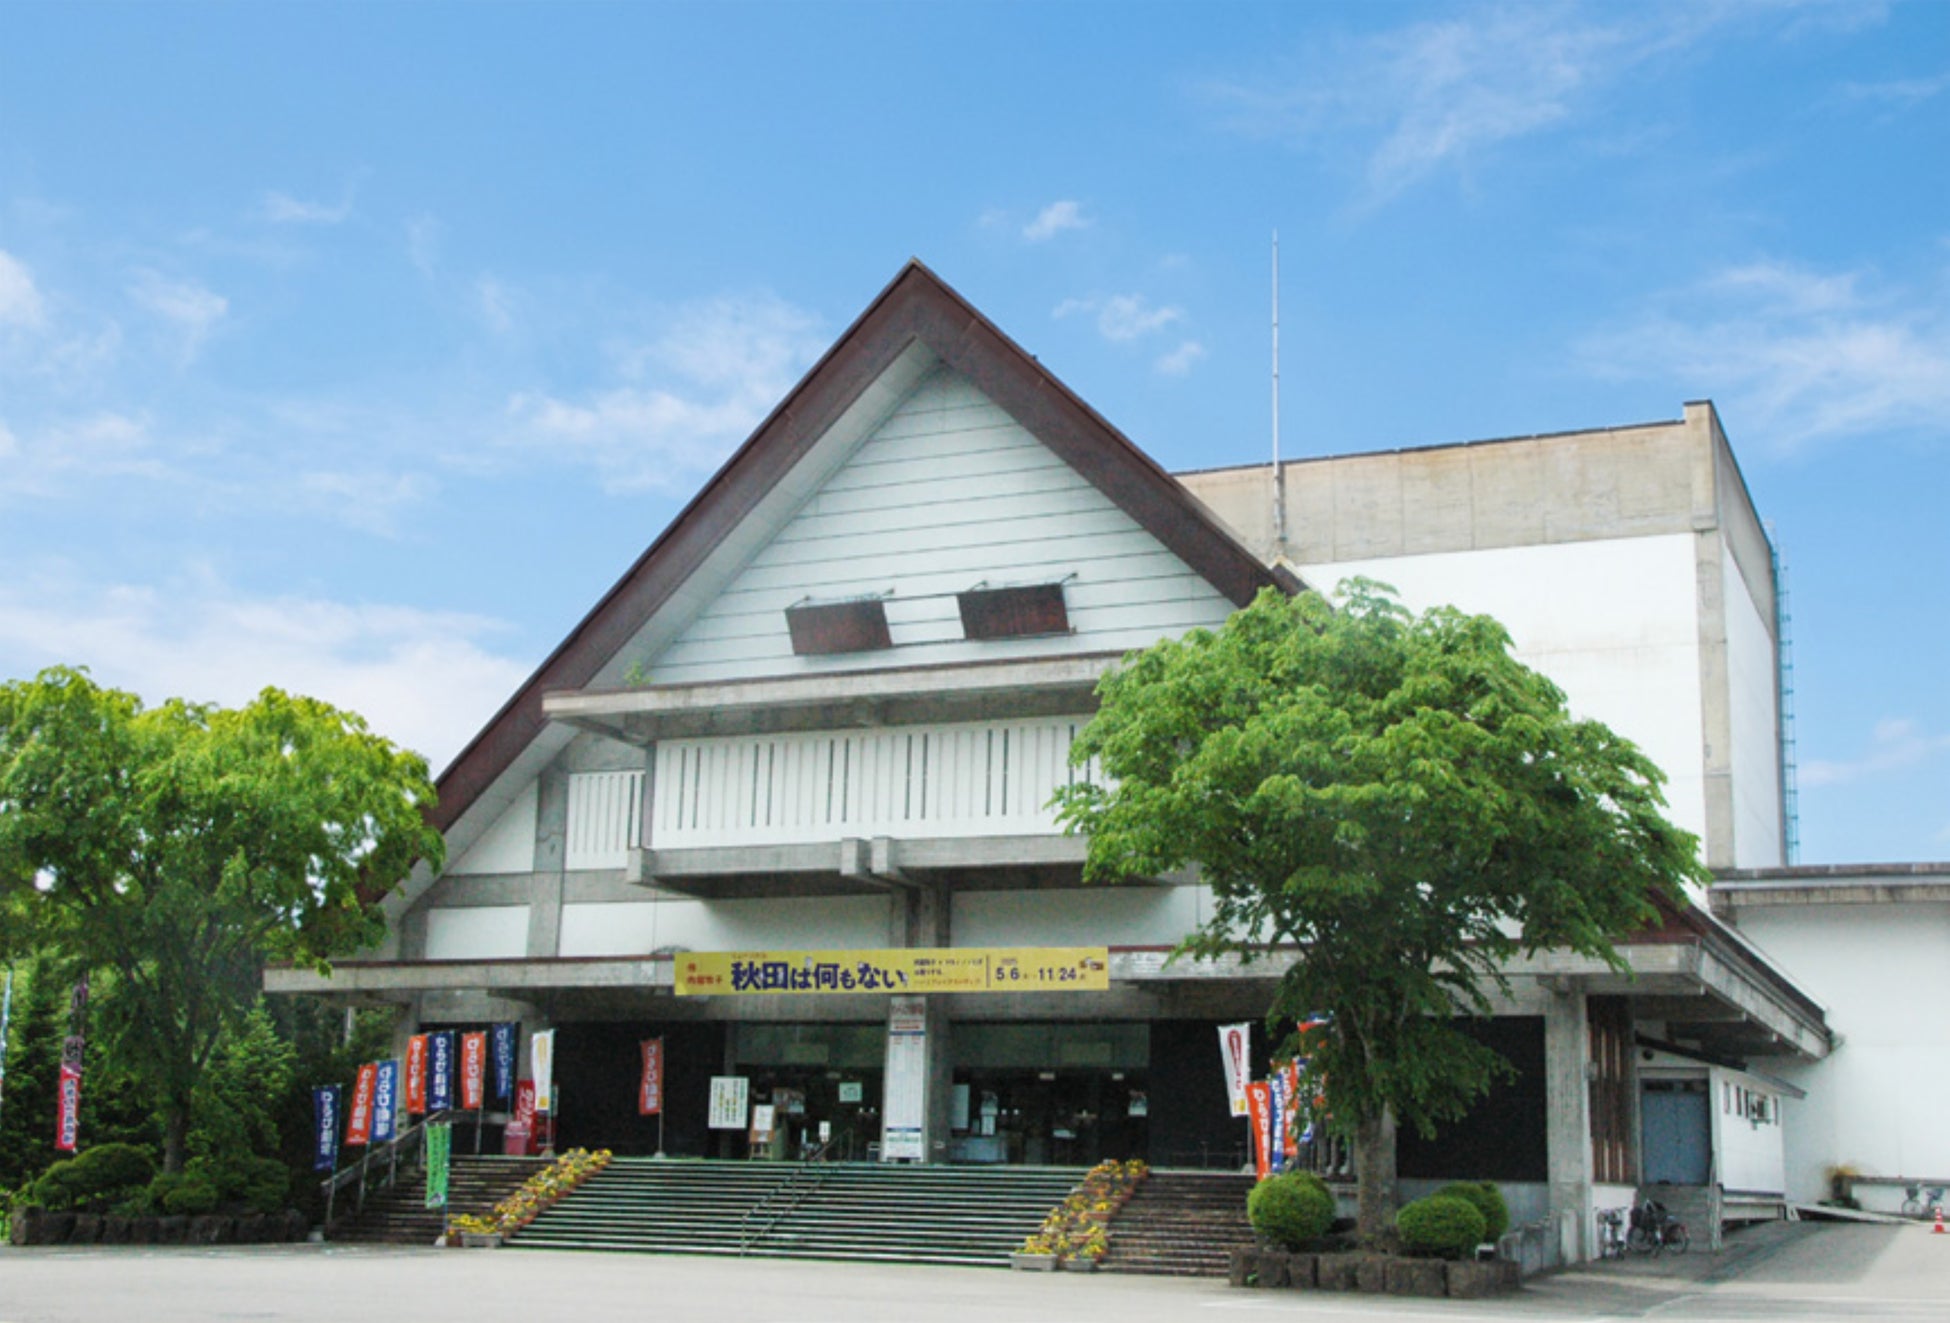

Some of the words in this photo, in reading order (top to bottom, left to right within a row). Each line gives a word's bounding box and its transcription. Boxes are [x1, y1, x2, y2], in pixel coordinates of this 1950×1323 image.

[731, 960, 908, 990] 秋田は何もない
[995, 966, 1005, 981] 5
[1010, 966, 1020, 981] 6
